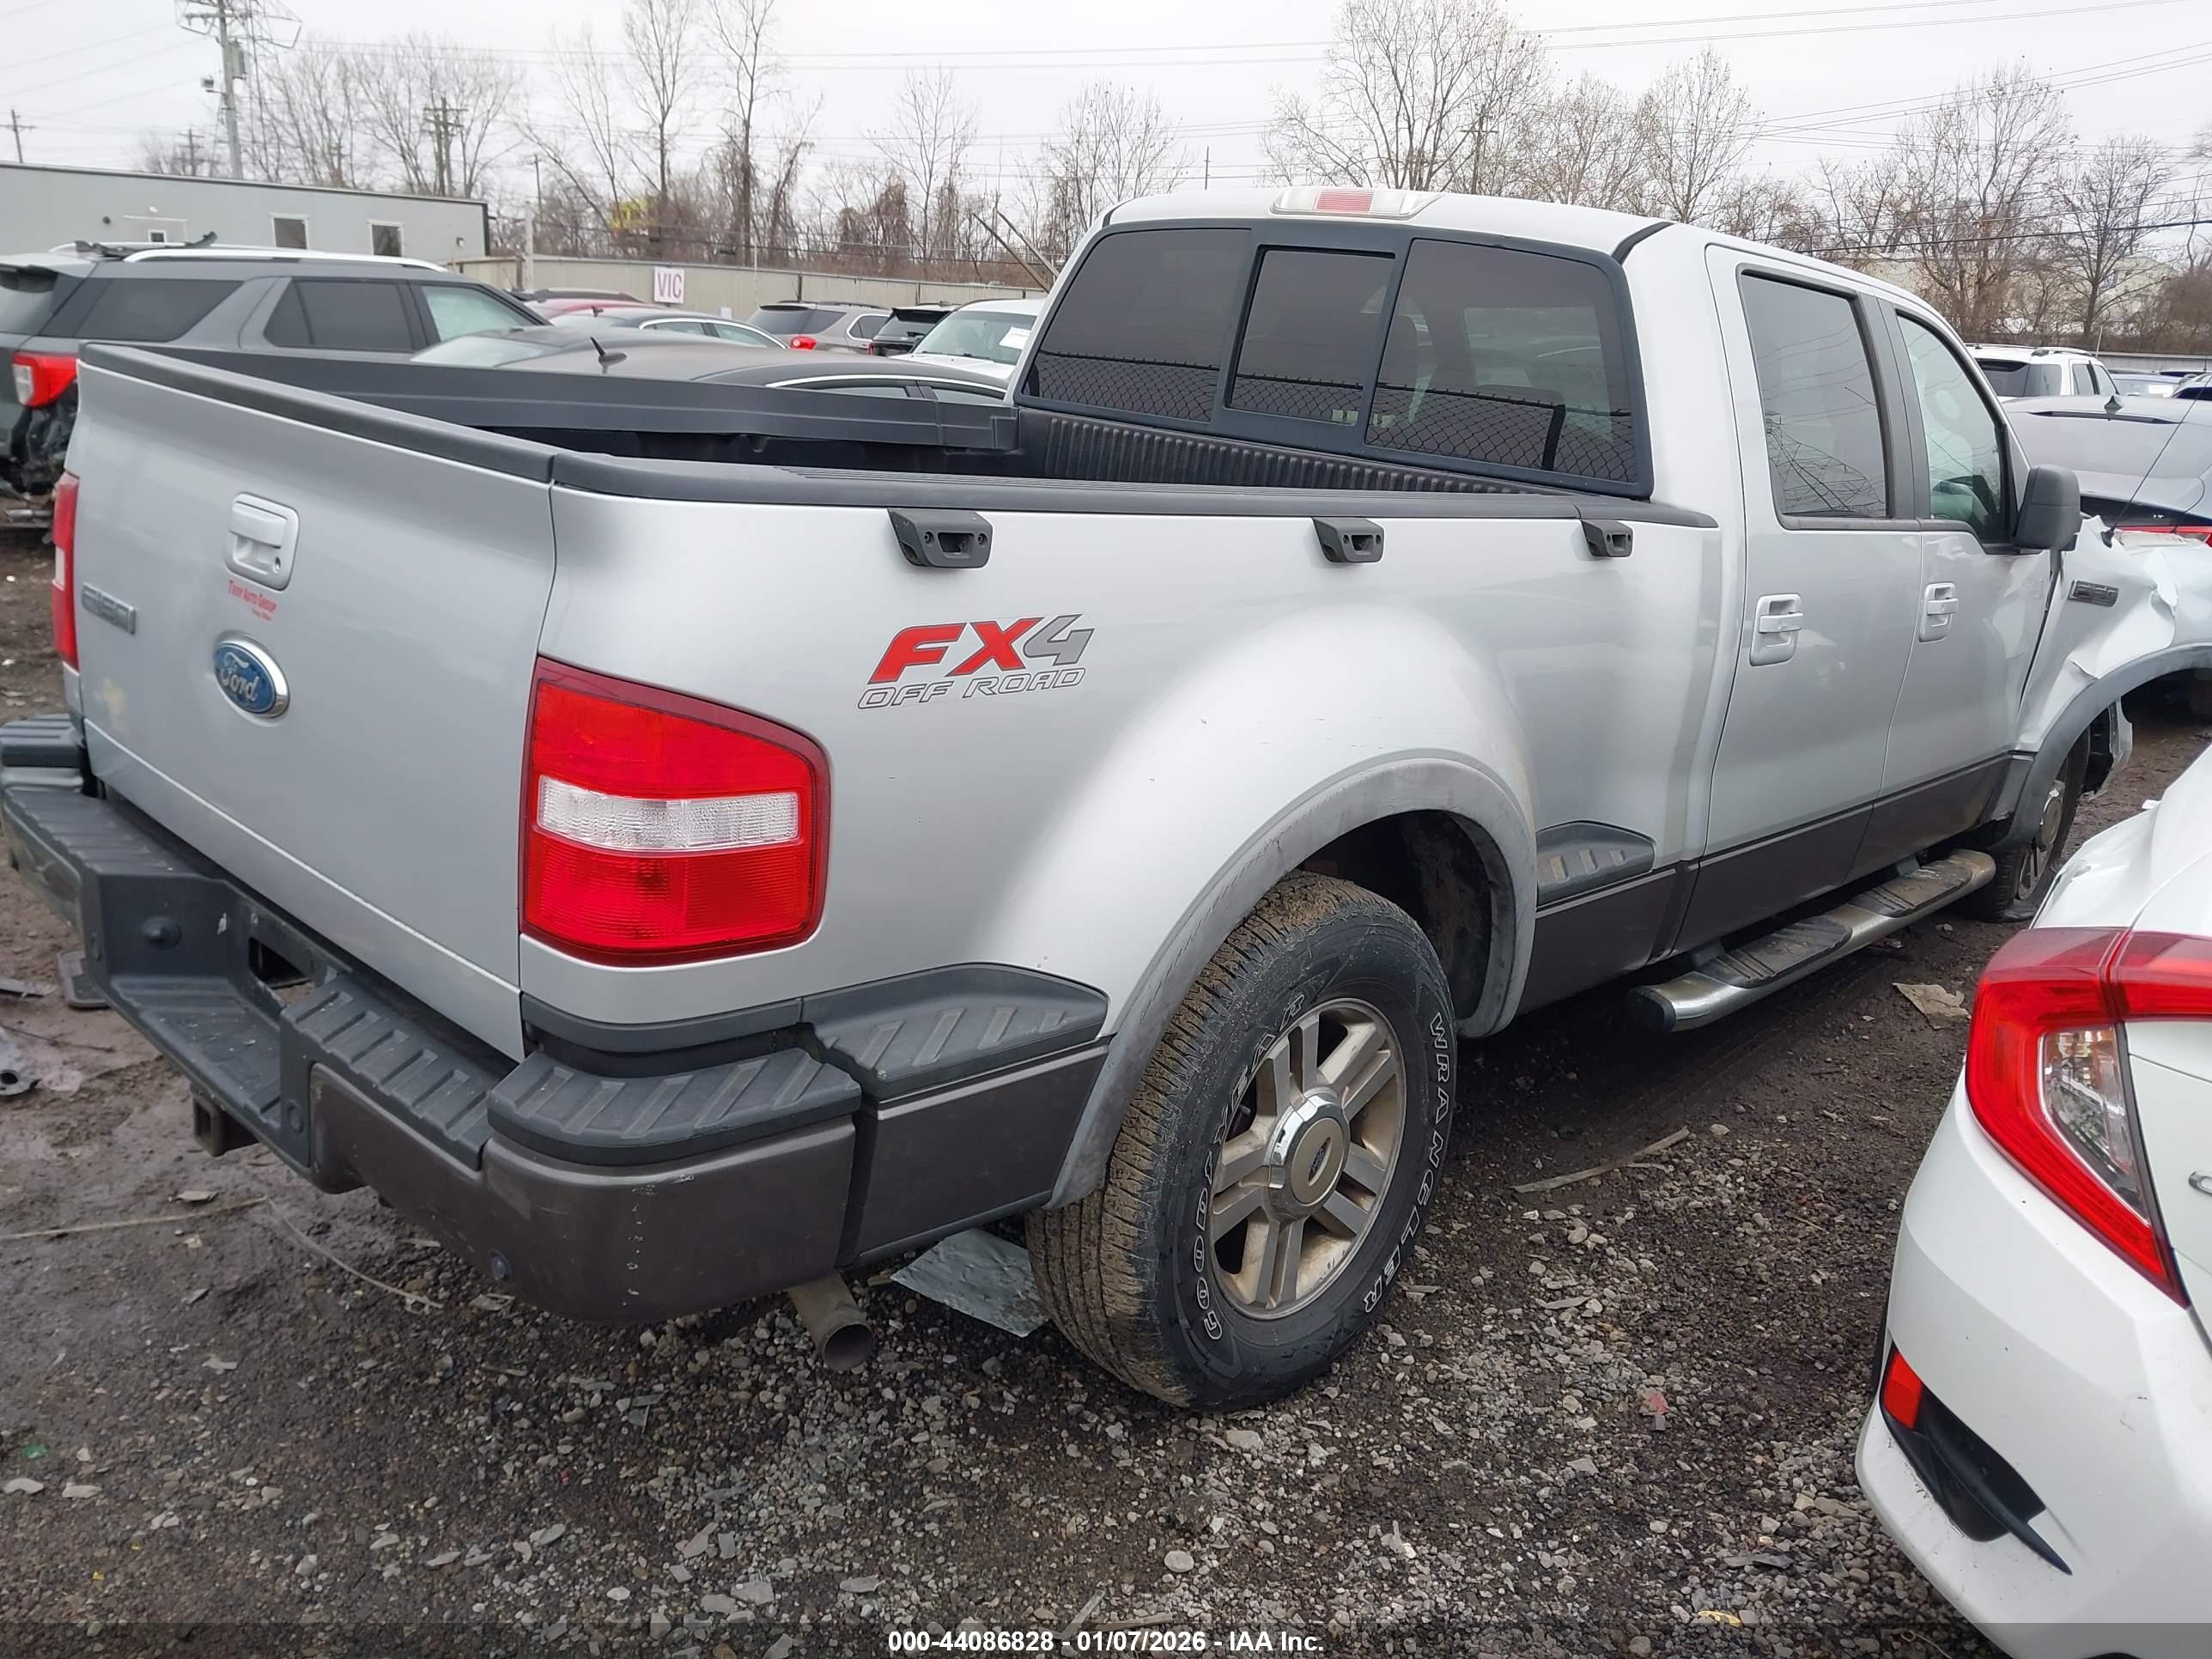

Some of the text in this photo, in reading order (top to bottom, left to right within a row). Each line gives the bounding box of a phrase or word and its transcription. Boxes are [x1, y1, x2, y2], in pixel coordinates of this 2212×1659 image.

[658, 272, 683, 299] VIC
[867, 613, 1095, 685] FX4
[221, 651, 260, 702] Ford
[858, 667, 1086, 710] OFF ROAD
[1363, 1011, 1451, 1313] WRANGLER
